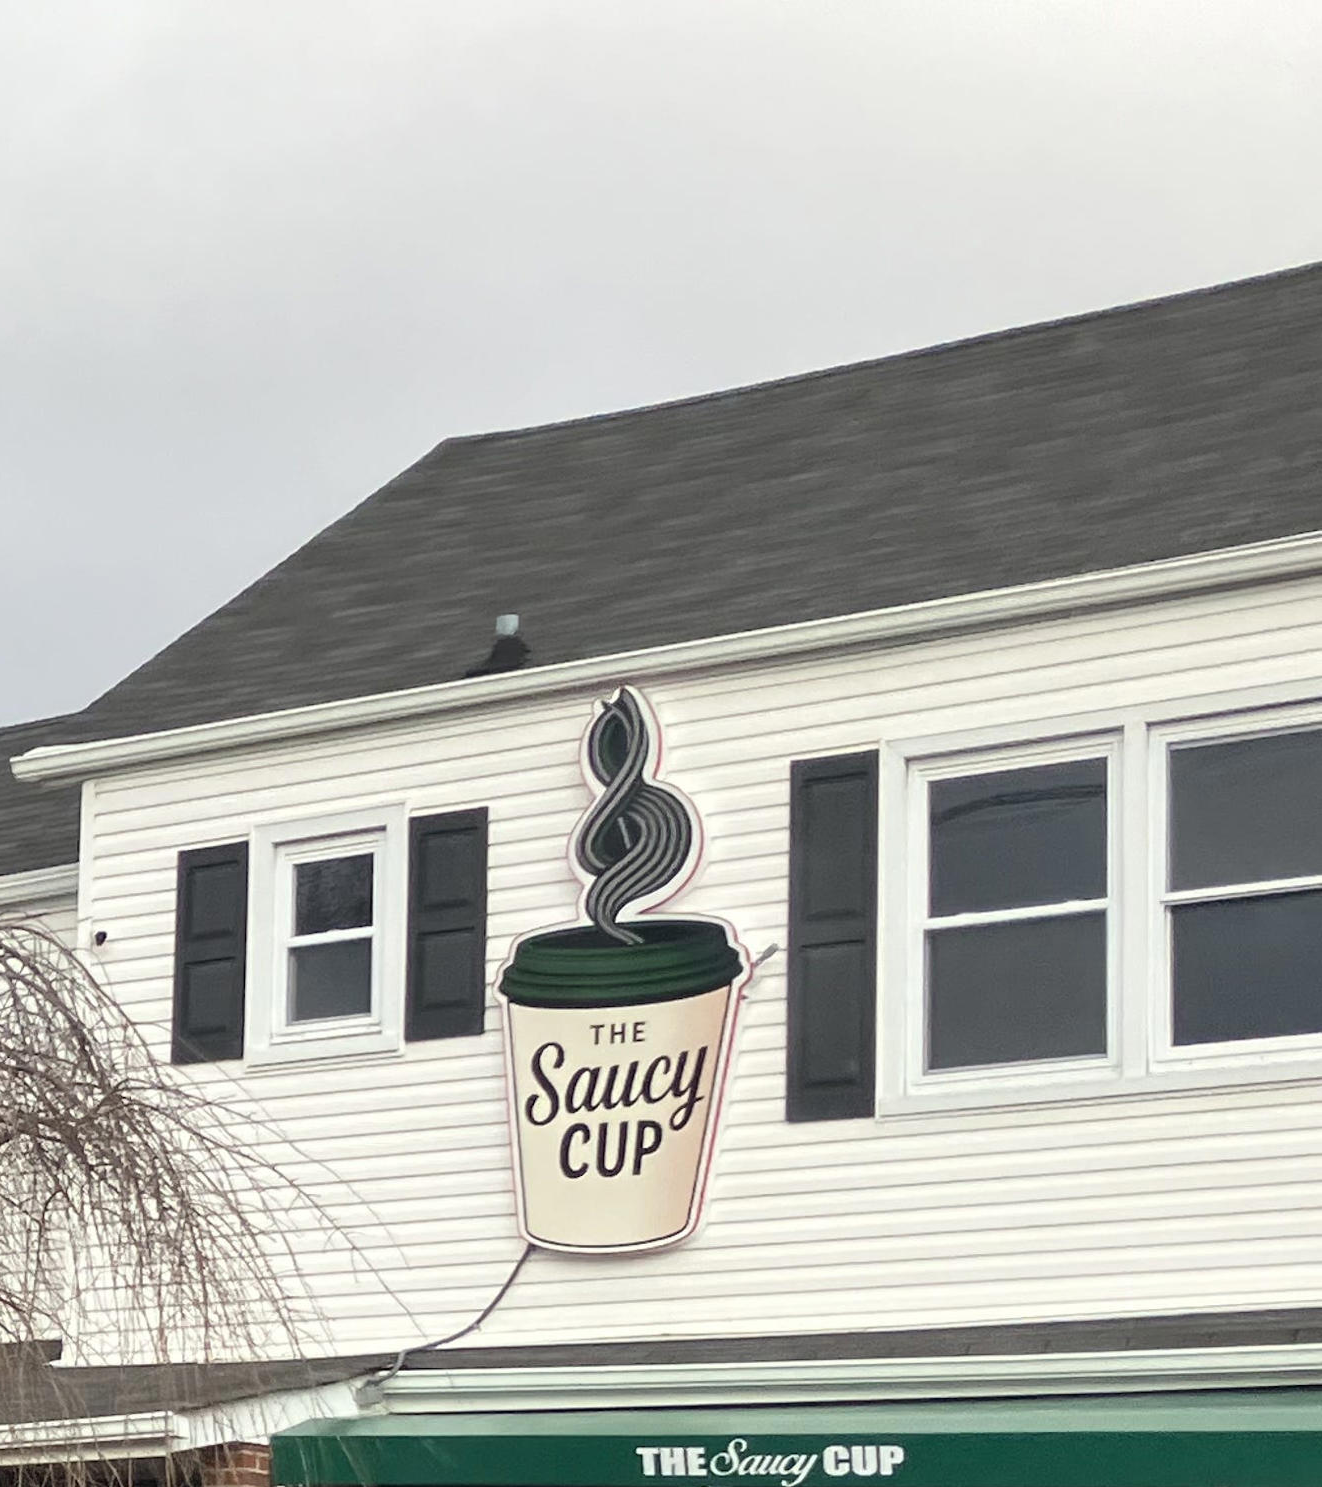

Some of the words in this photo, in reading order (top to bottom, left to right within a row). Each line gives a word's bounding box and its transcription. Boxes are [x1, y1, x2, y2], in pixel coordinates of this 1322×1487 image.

[590, 1021, 647, 1045] THE
[525, 1042, 708, 1131] Saucy
[559, 1120, 663, 1179] CUP
[636, 1447, 707, 1476] THE
[710, 1438, 818, 1487] Saucy
[823, 1446, 904, 1476] CUP
